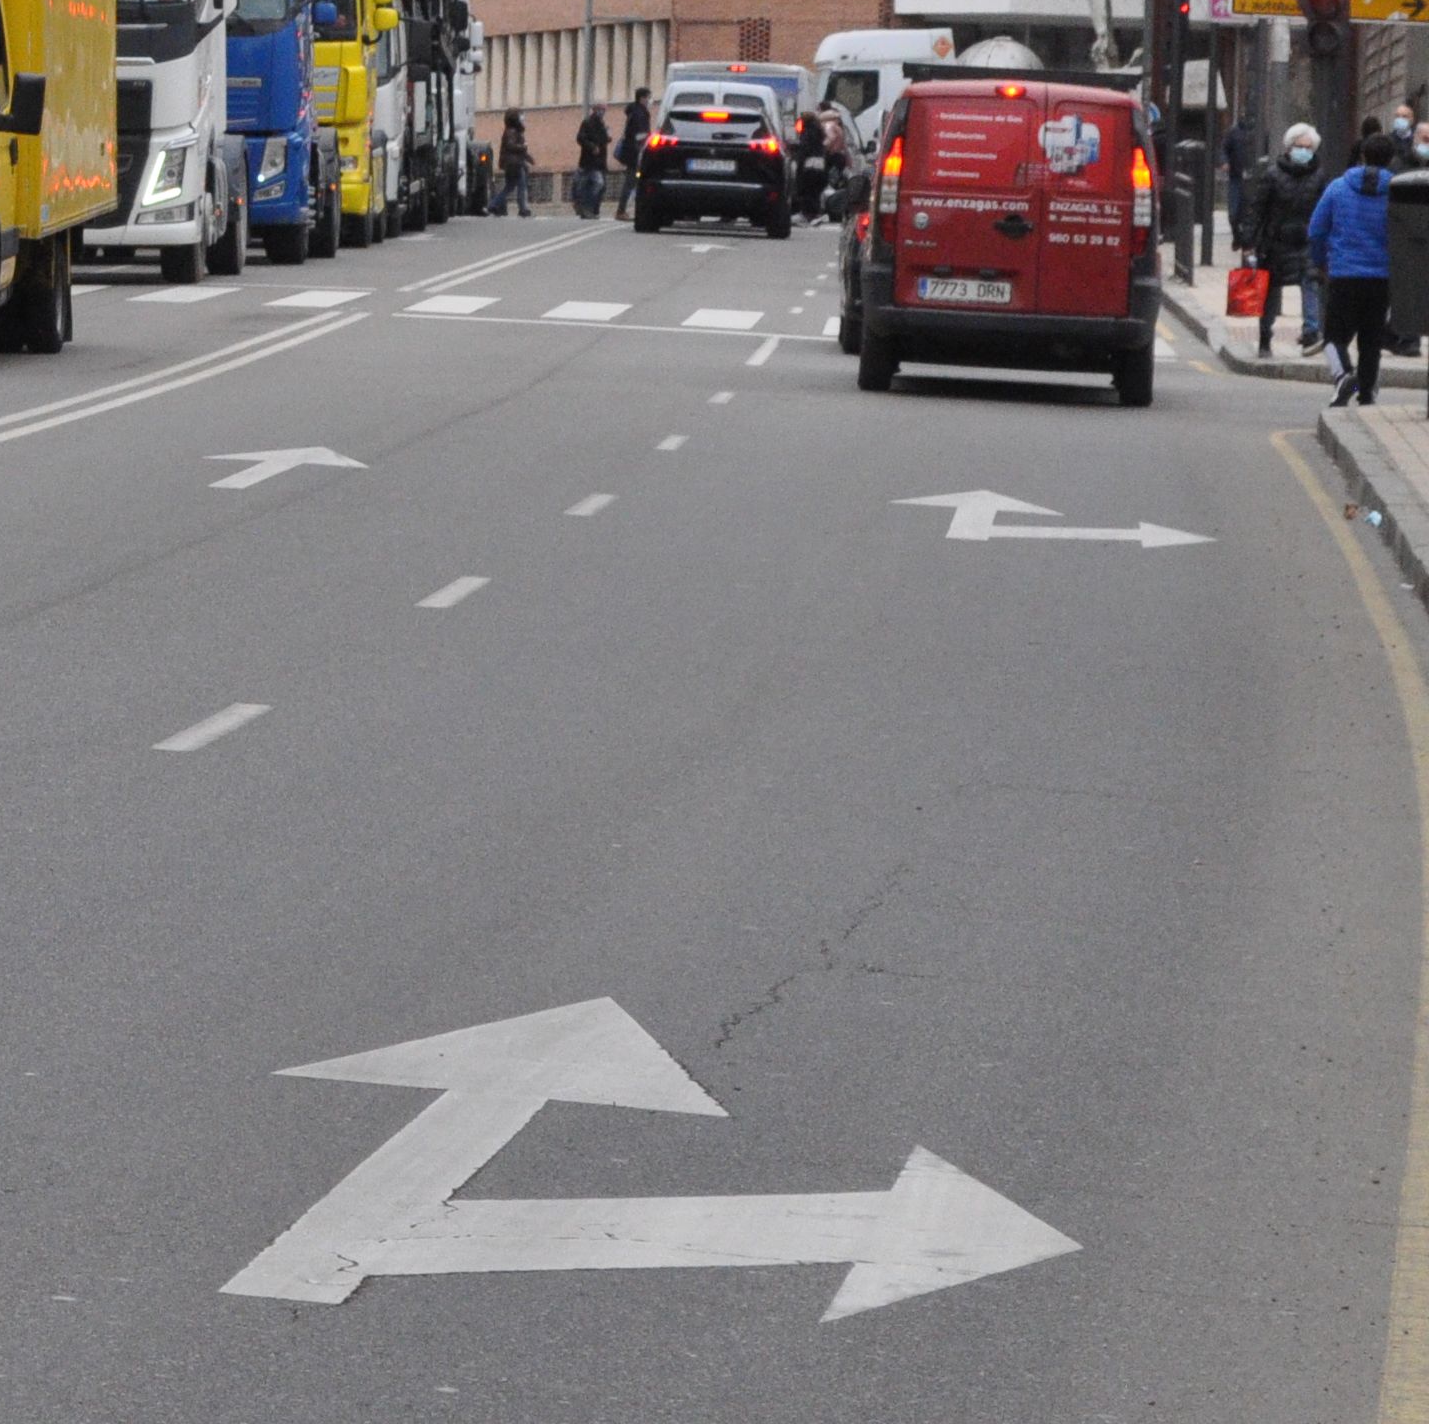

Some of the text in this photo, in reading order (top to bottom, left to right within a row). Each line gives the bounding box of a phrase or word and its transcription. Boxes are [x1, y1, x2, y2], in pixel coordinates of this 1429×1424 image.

[912, 197, 1029, 212] www.enzagas.com
[930, 280, 1005, 298] 7773 DRN
